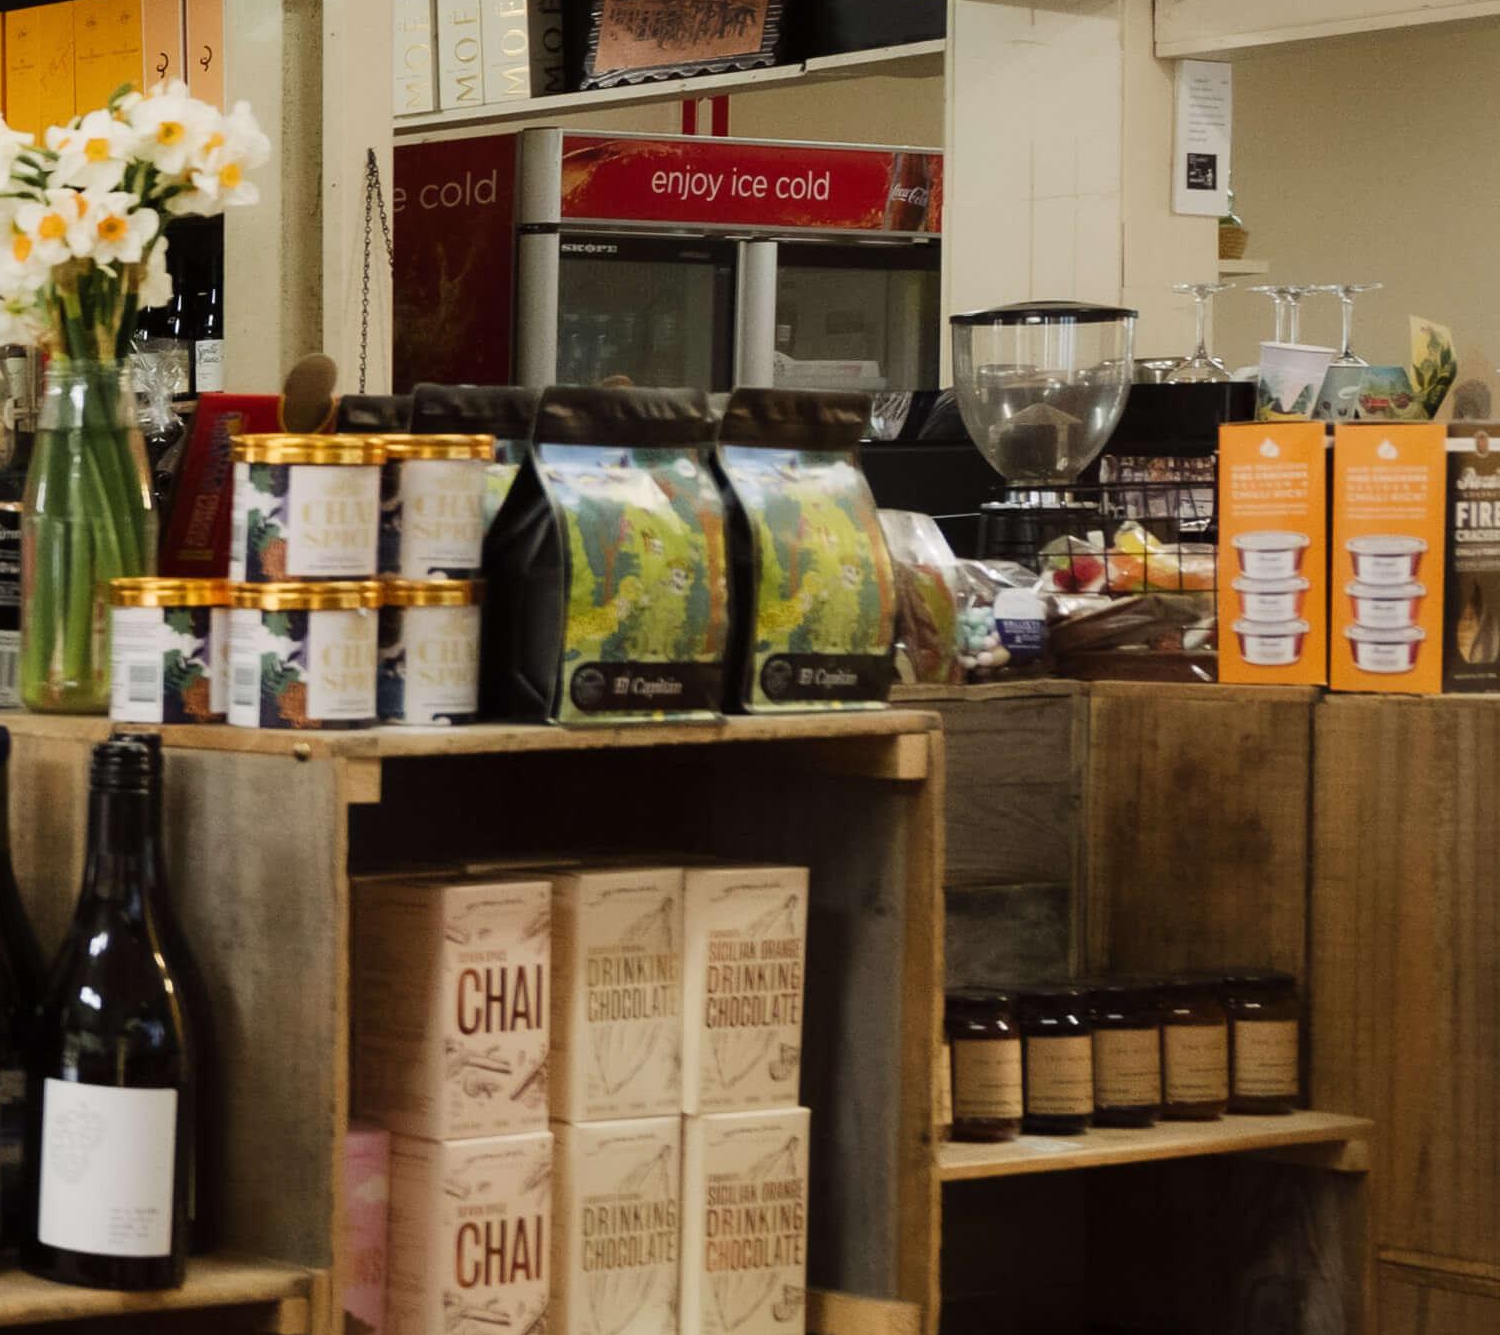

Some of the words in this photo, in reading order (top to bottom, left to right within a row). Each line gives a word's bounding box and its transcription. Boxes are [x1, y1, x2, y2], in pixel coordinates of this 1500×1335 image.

[420, 169, 498, 210] cold
[651, 166, 723, 202] enjoy
[731, 166, 769, 199] ice
[775, 170, 831, 201] cold
[560, 242, 619, 253] SKOPE
[587, 952, 679, 987] DRINKING
[707, 963, 799, 993] DRINKING
[457, 963, 543, 1035] CHAI
[587, 984, 679, 1023] CHOCOLATE
[706, 992, 799, 1028] CHOCOLATE
[583, 1199, 676, 1237] DRINKING
[707, 1203, 804, 1236] DRINKING
[455, 1214, 543, 1289] CHAI
[583, 1232, 676, 1272] CHOCOLATE
[706, 1234, 802, 1272] CHOCOLATE
